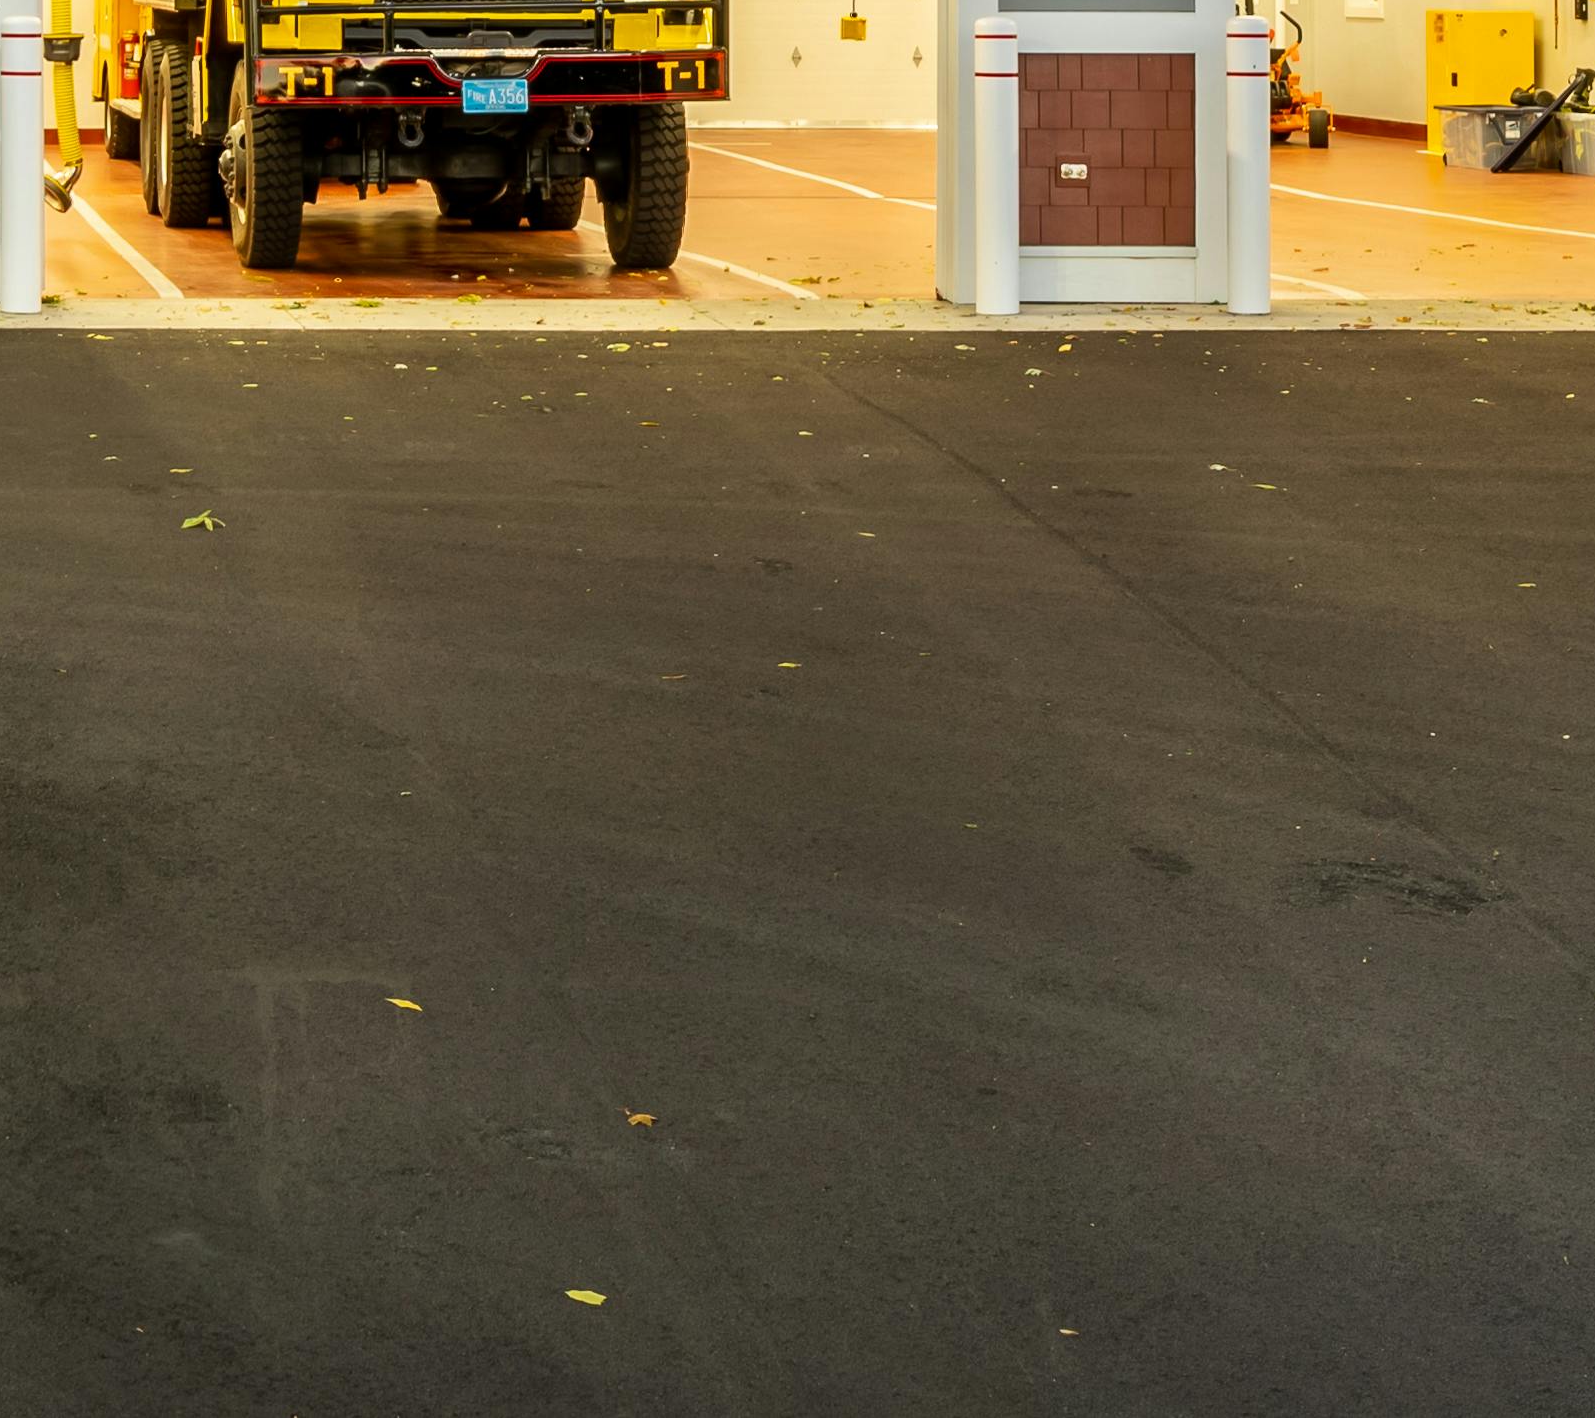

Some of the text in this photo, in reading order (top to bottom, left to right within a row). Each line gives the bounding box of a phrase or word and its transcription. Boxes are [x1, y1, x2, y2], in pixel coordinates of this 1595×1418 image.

[278, 66, 333, 96] T-1
[657, 60, 705, 91] T-1
[467, 88, 525, 104] FIRE A356
